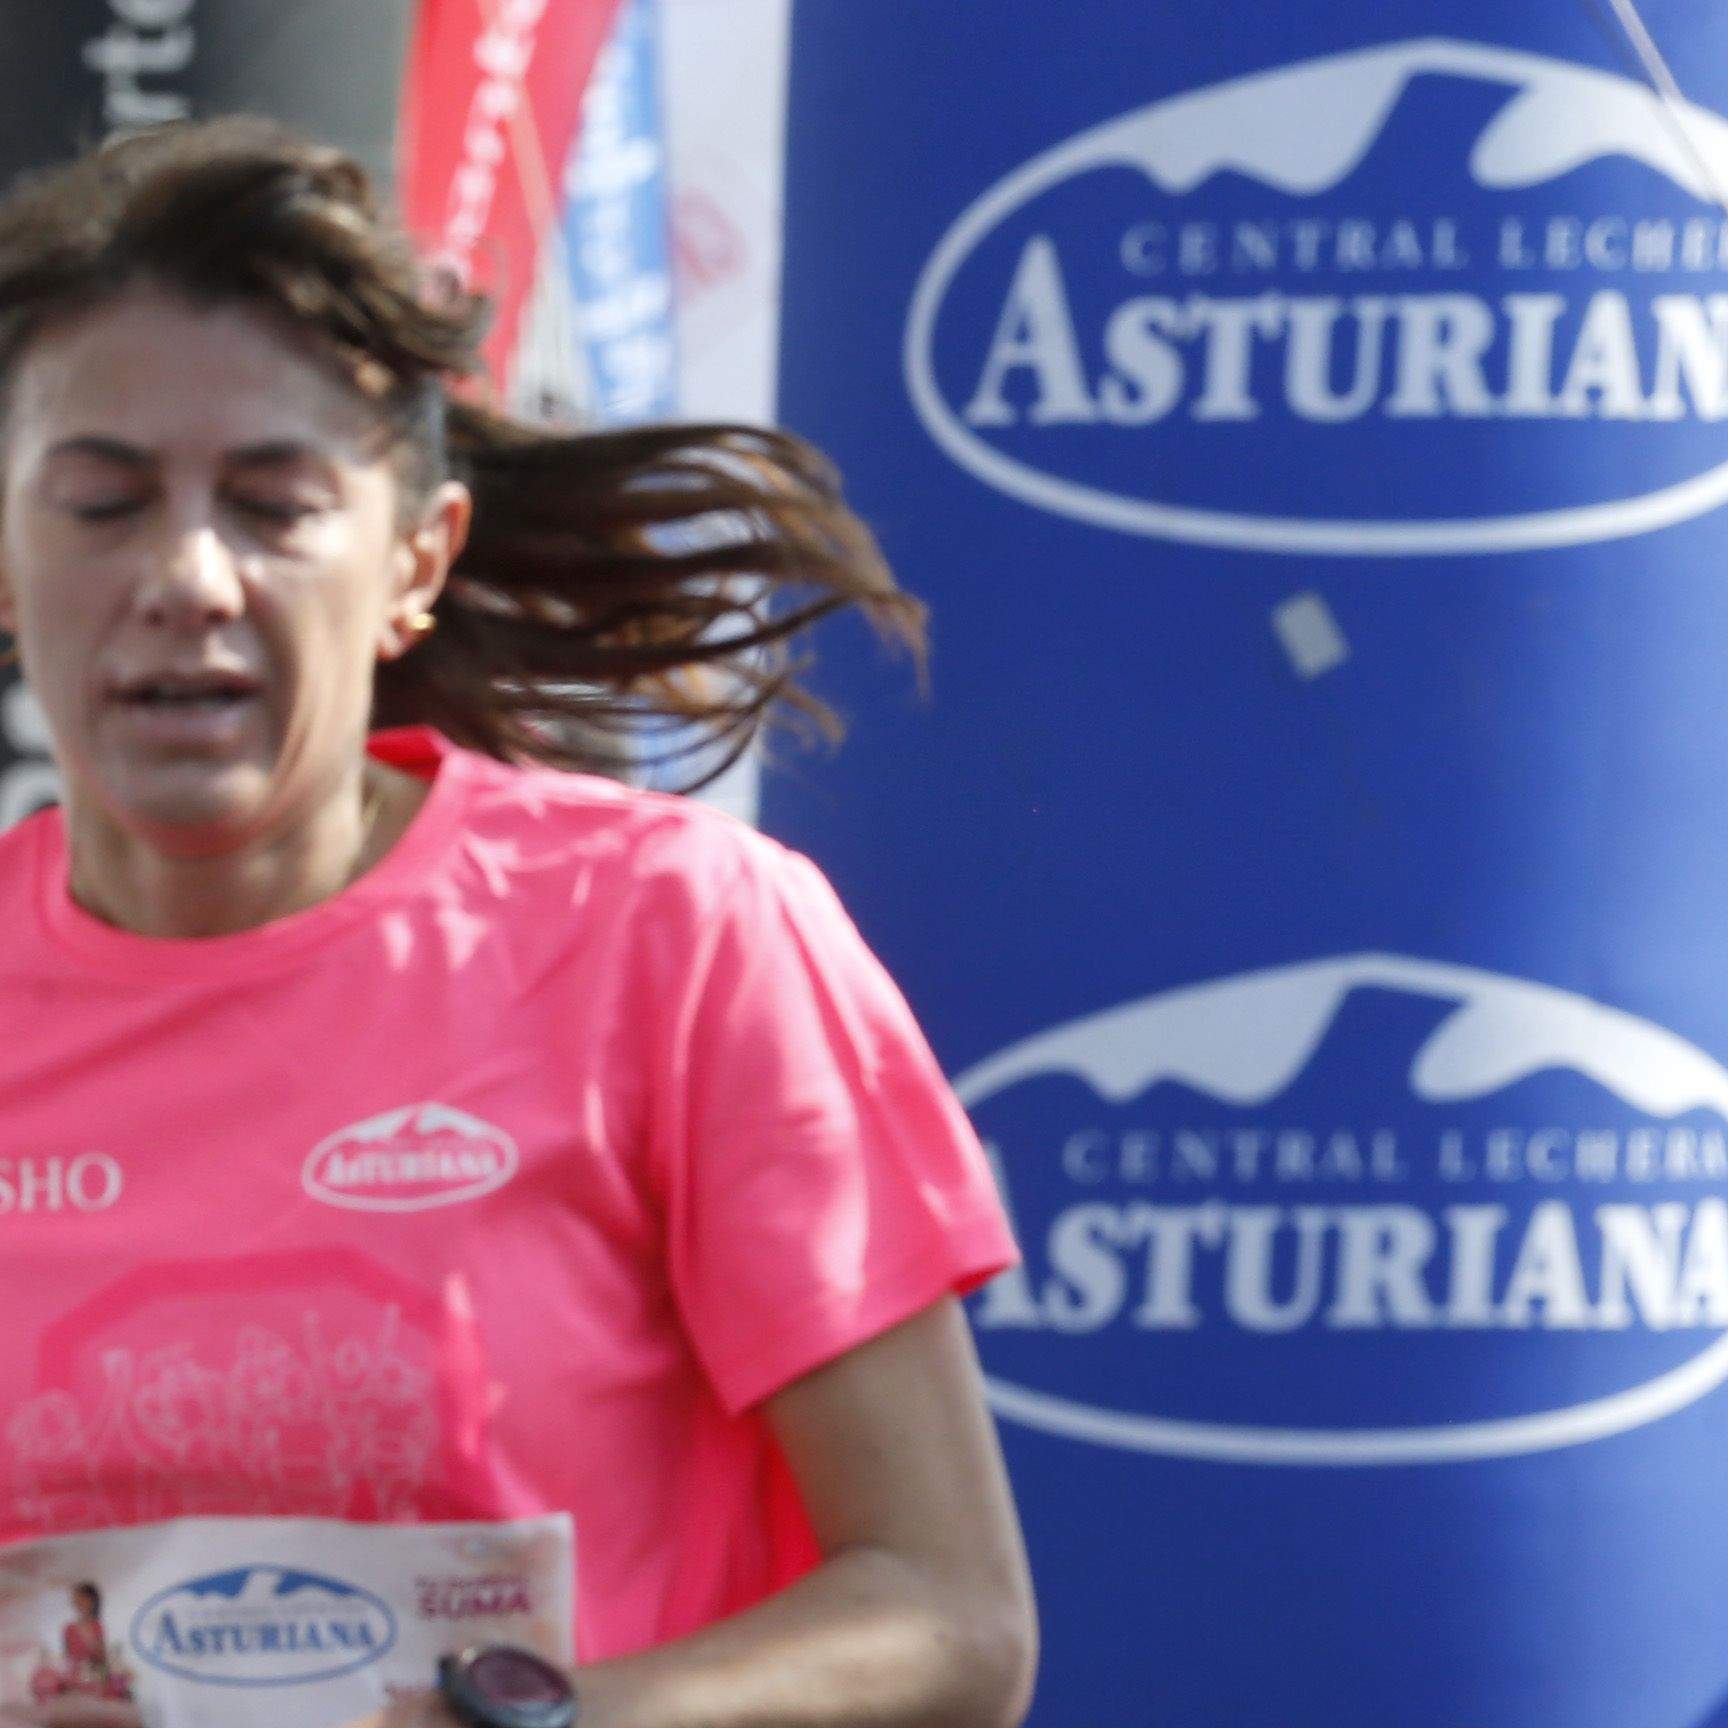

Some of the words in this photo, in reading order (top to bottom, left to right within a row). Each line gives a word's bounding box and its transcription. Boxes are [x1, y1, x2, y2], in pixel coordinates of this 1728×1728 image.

[1120, 216, 1468, 275] CENTRAL
[1500, 214, 1728, 274] LECHE
[965, 236, 1728, 427] ASTURIAN
[1061, 1128, 1407, 1183] CENTRAL
[152, 1609, 378, 1655] ASTURIANA
